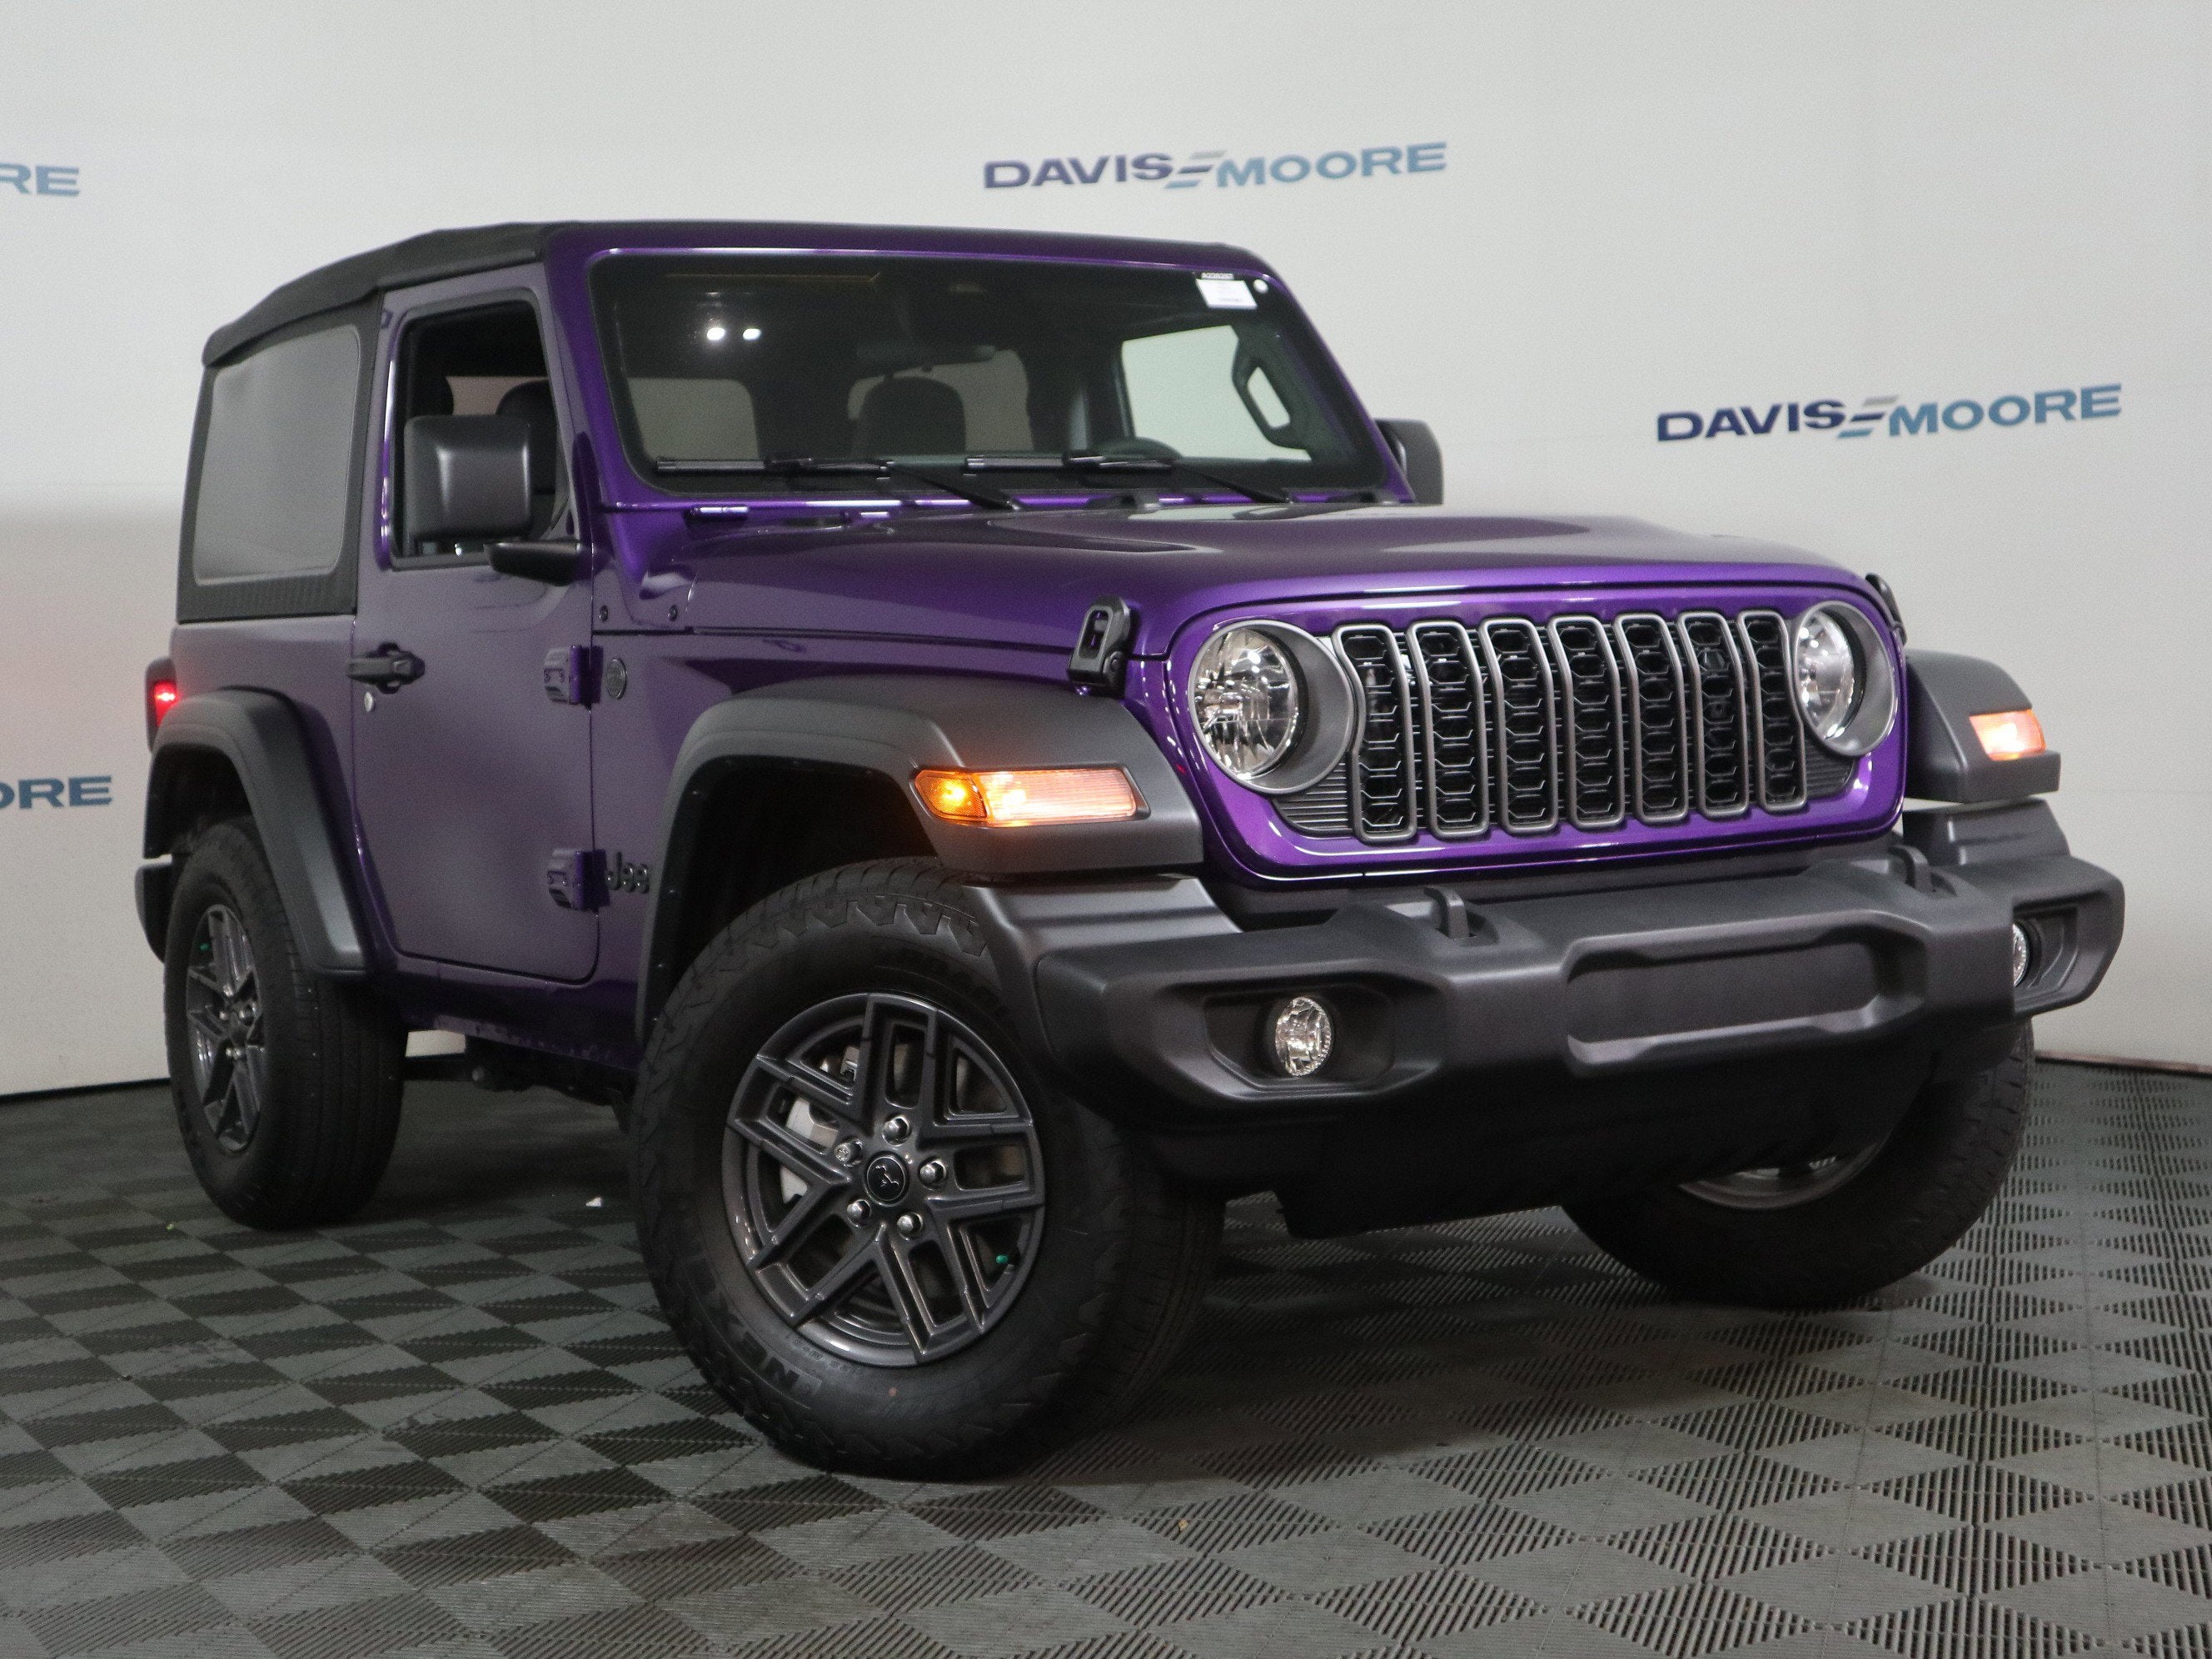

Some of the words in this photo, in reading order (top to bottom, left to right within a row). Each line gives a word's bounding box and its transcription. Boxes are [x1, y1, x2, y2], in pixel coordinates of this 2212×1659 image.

[984, 152, 1173, 190] DAVIS
[1216, 141, 1447, 188] MOORE
[1657, 399, 1846, 442] DAVIS
[1889, 383, 2122, 437] MOORE
[605, 851, 650, 894] Jee
